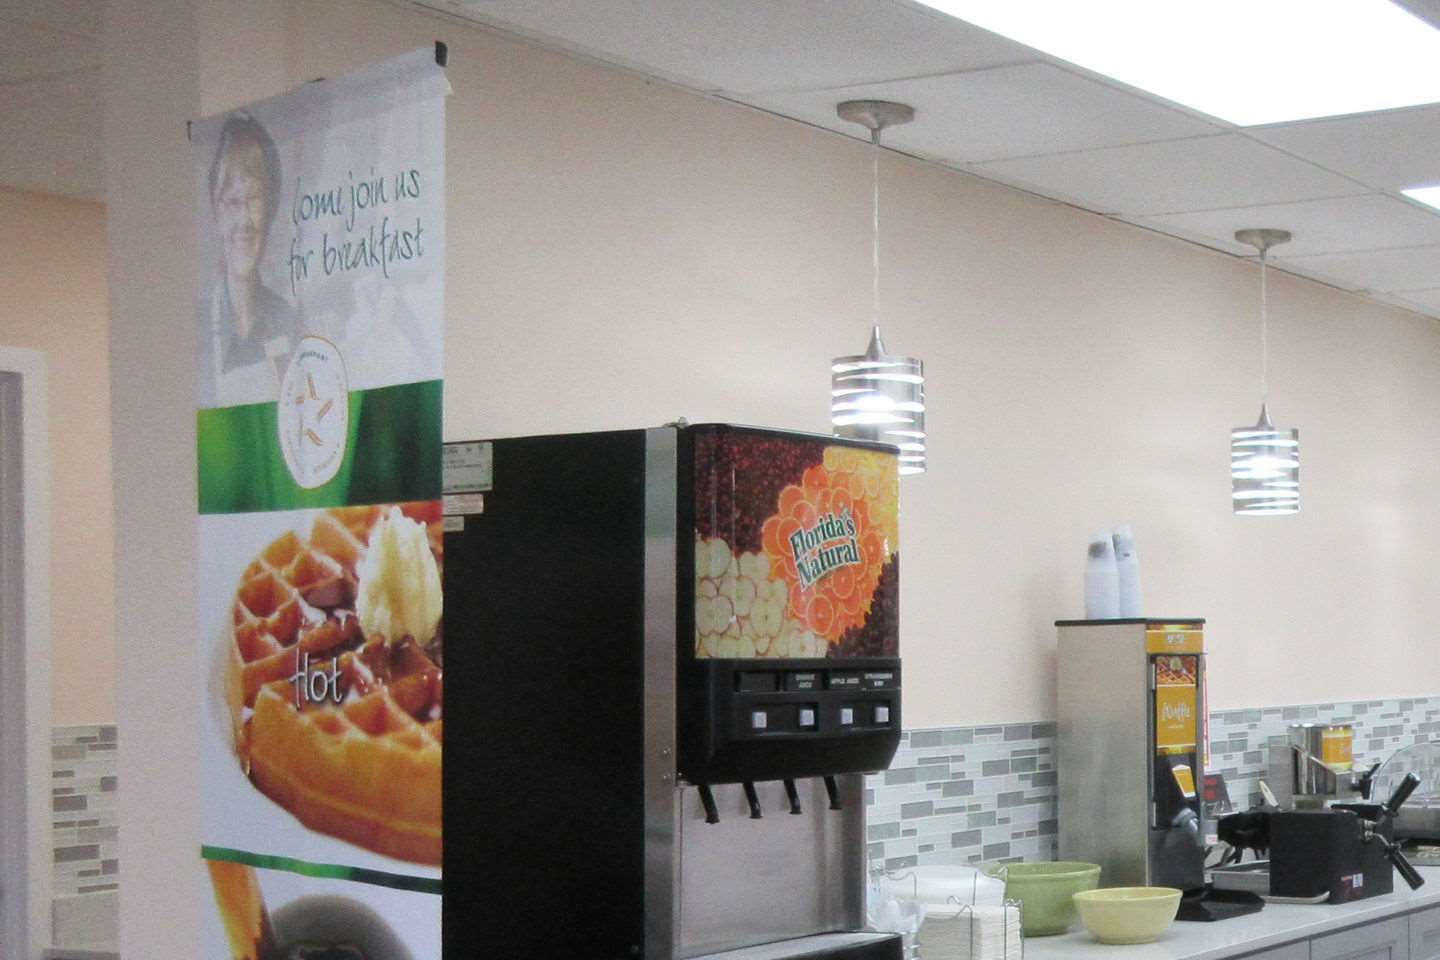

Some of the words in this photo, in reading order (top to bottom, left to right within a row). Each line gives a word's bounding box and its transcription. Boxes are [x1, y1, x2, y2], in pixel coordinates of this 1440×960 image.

[346, 167, 388, 232] join
[396, 169, 420, 201] us
[323, 216, 425, 280] breakfast
[790, 510, 856, 561] Florida's
[796, 538, 859, 590] Natural
[288, 648, 343, 712] Hot
